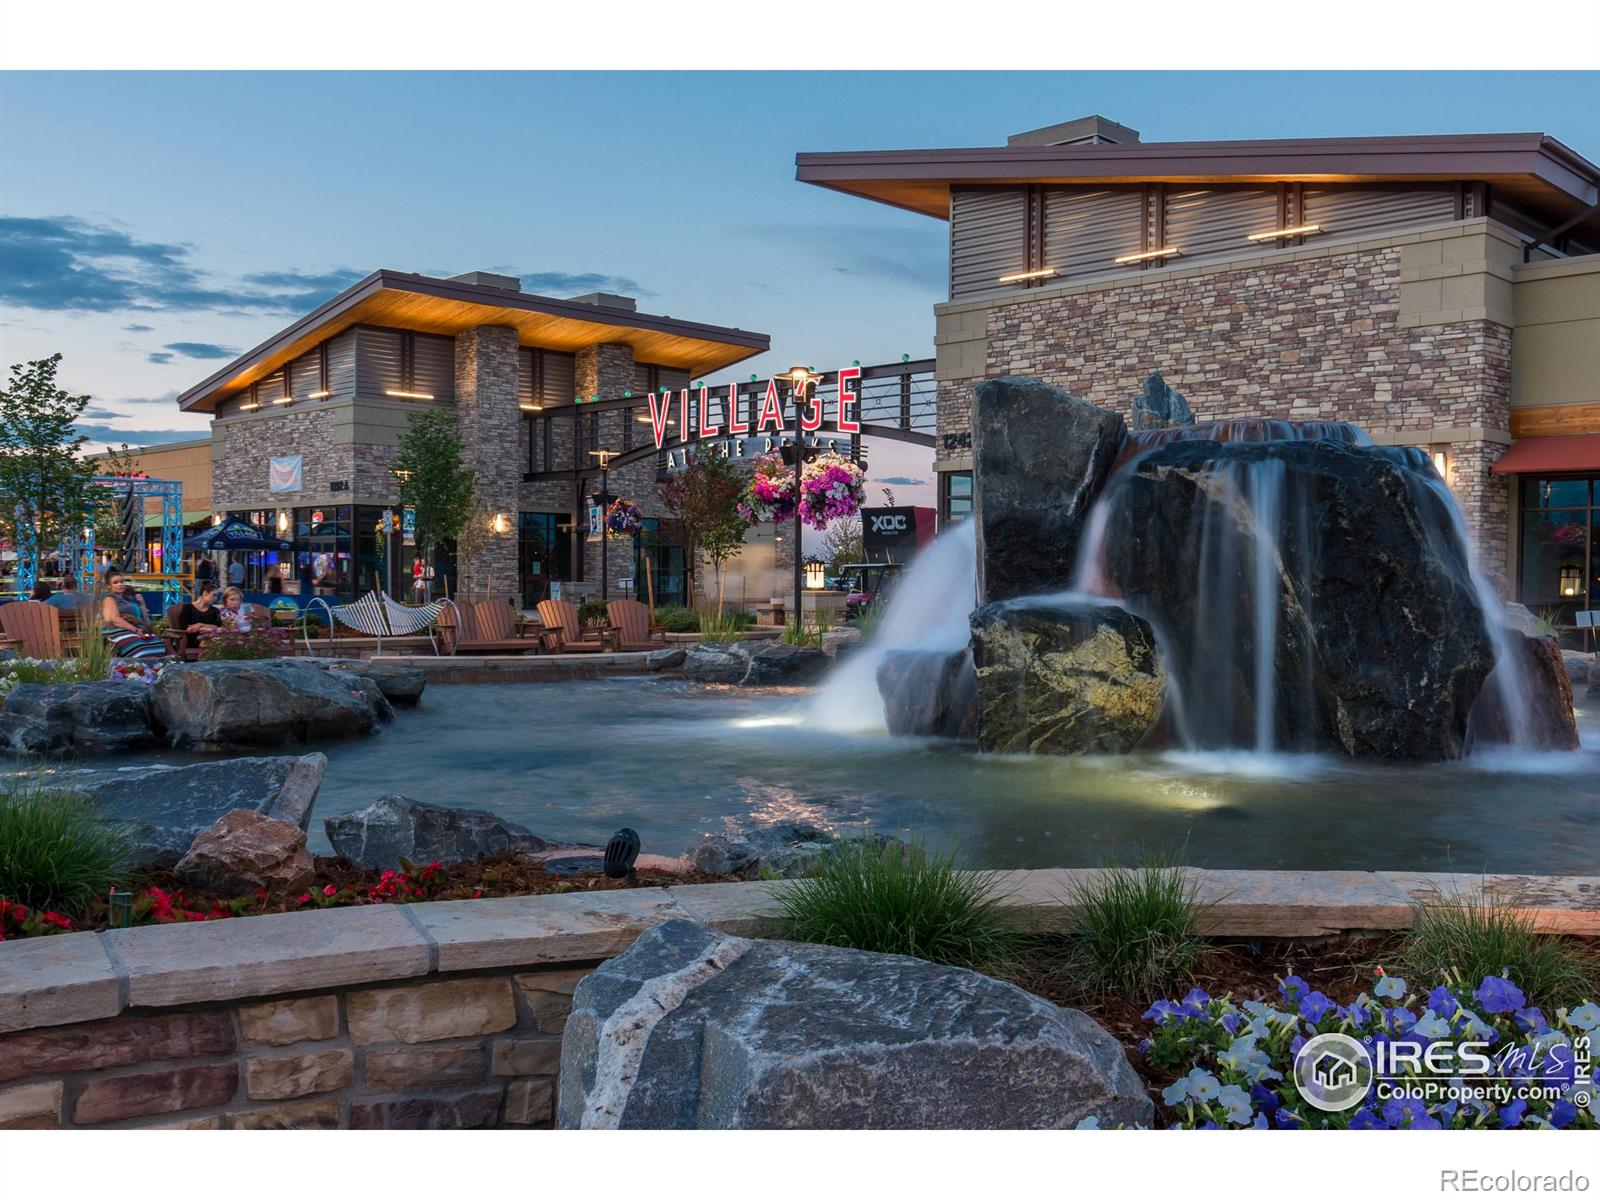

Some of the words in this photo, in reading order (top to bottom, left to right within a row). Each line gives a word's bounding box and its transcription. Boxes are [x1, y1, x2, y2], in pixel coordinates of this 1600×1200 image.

[648, 366, 861, 449] VILLAGE
[667, 448, 686, 469] AT
[765, 437, 835, 454] PKS
